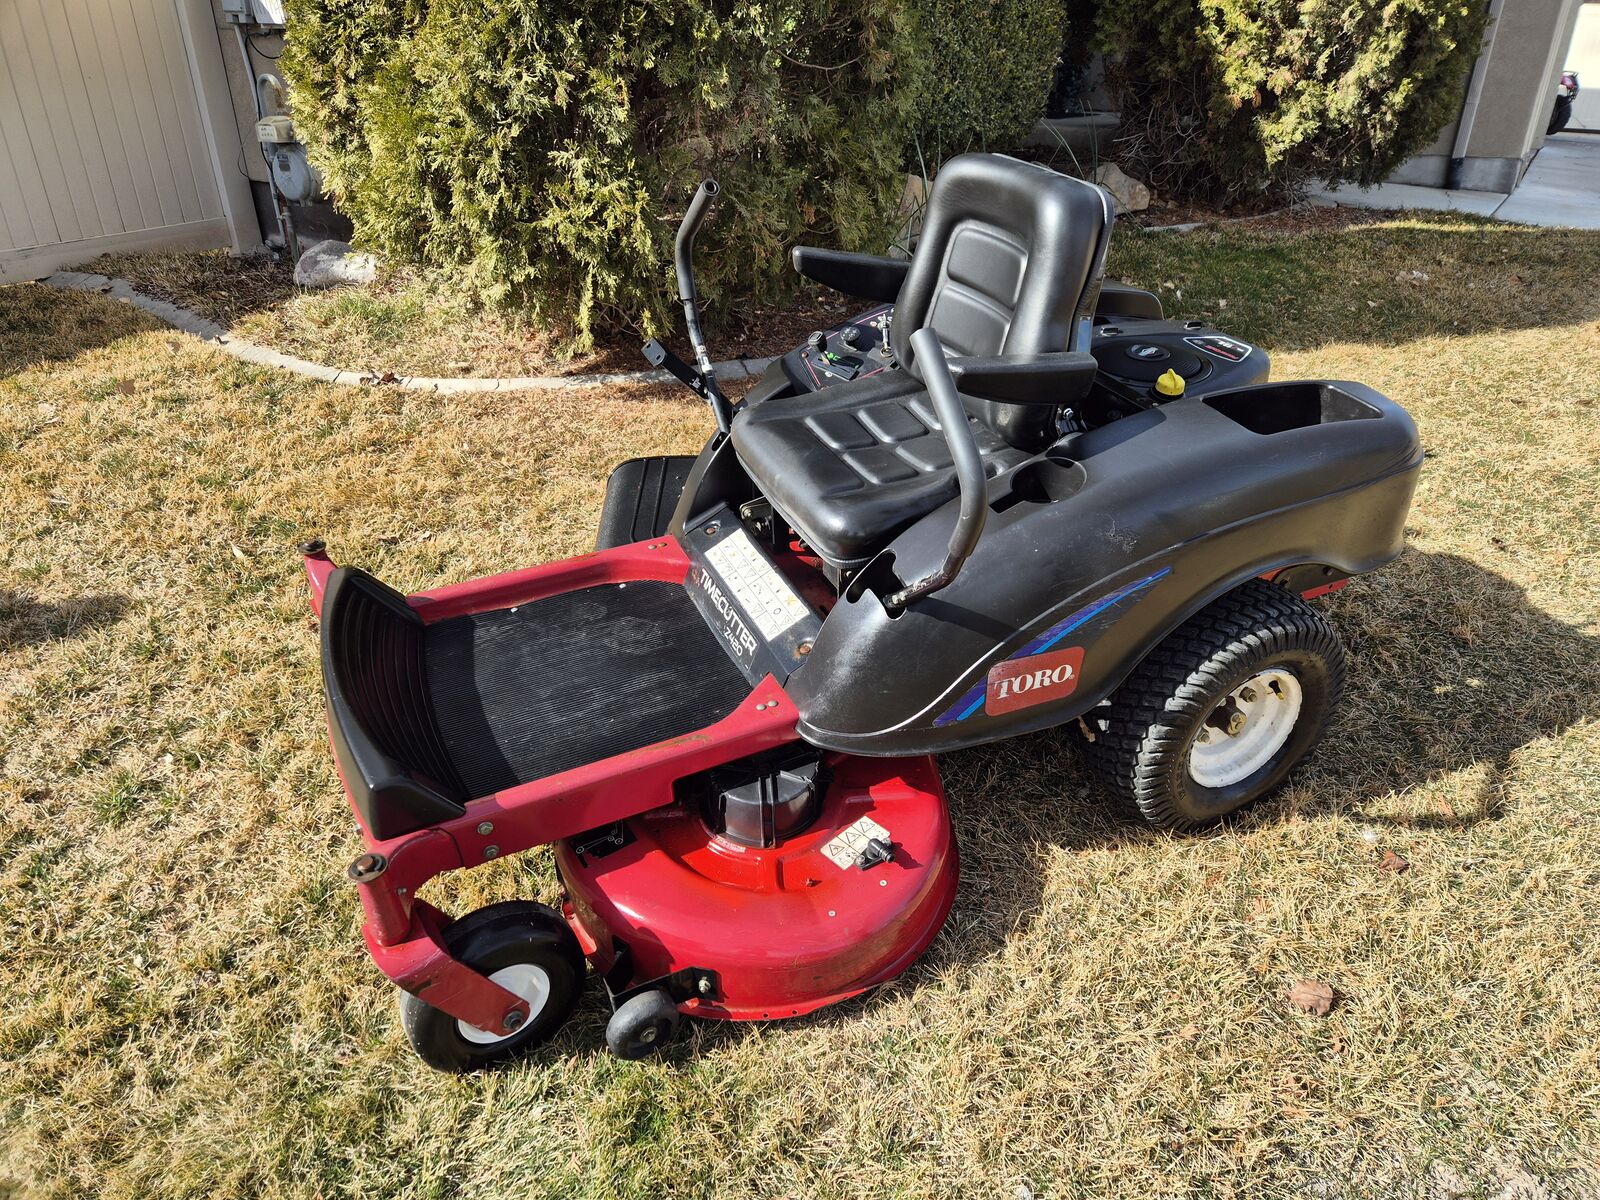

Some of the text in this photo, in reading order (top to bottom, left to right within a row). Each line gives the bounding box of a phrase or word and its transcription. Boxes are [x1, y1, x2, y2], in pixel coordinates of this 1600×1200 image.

[700, 568, 757, 656] TIMECUTTER
[724, 627, 743, 656] Z420
[994, 664, 1073, 700] TORO
